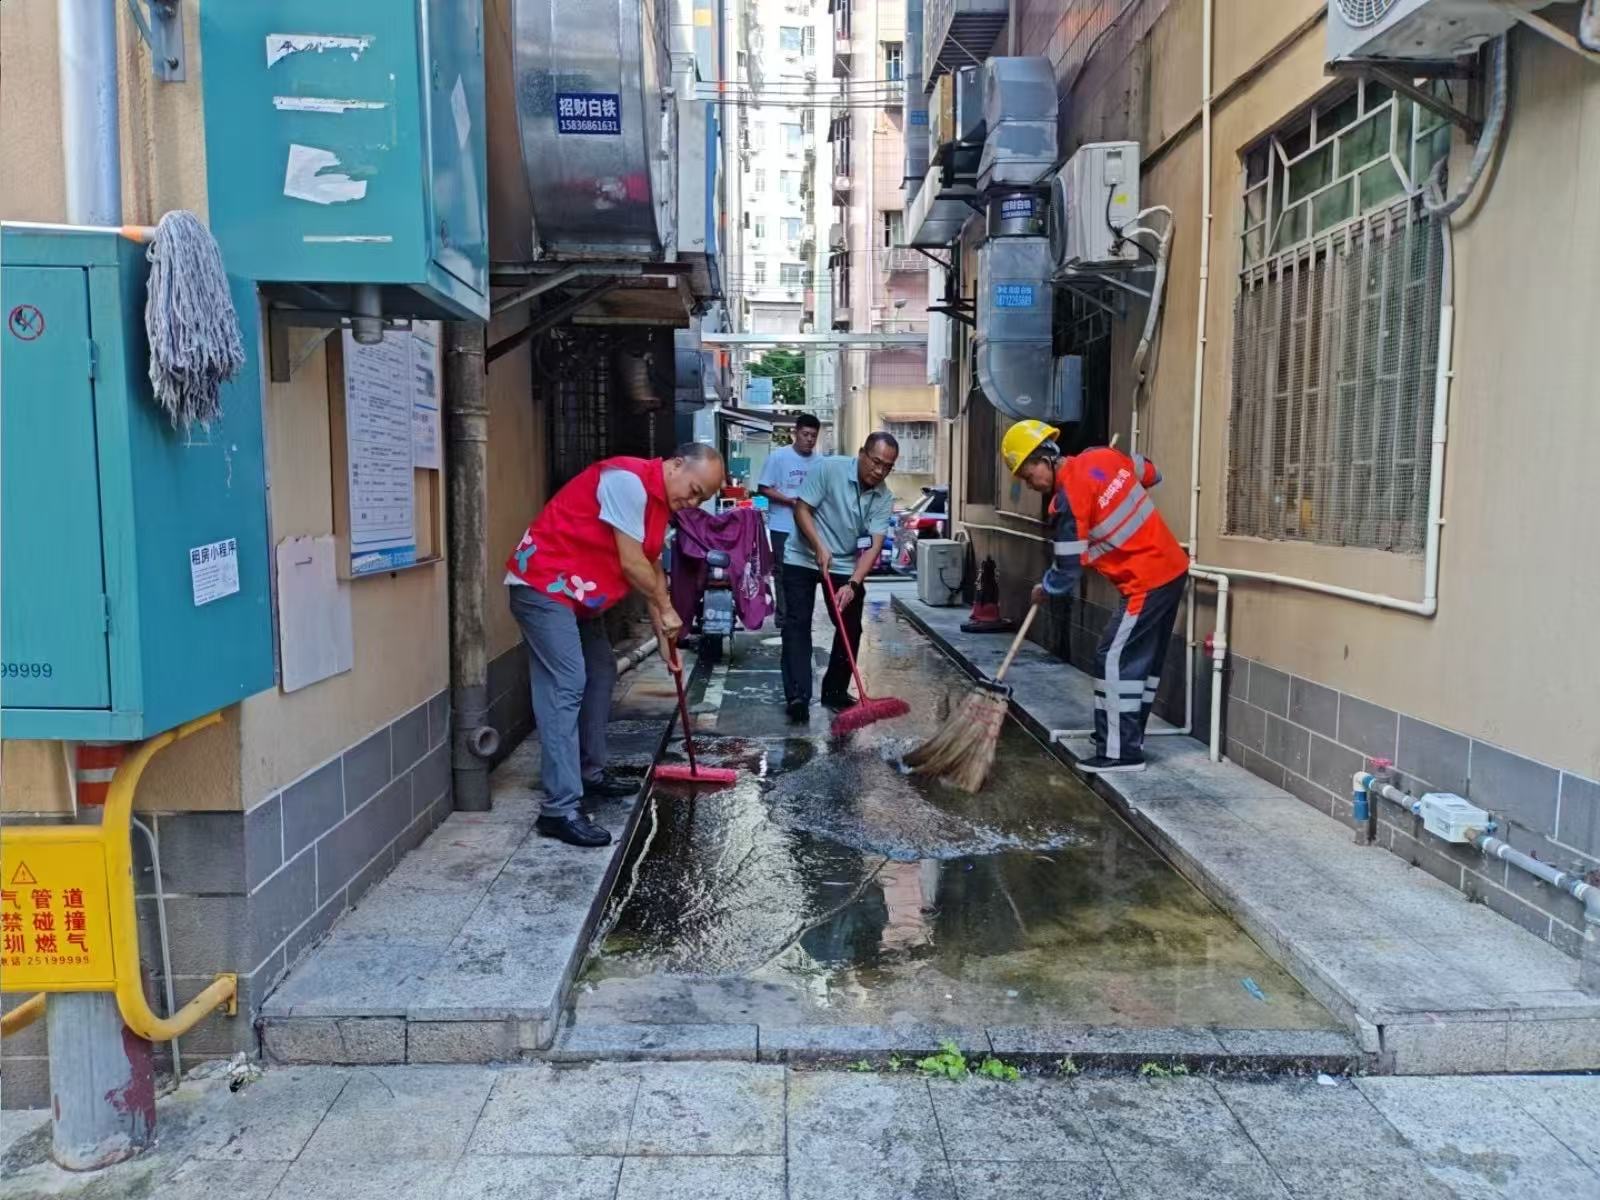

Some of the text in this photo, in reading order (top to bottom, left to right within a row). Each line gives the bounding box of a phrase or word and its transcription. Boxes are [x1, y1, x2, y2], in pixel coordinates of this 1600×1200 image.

[559, 98, 617, 117] 招财白铁
[191, 540, 236, 565] 租房小程序
[1, 888, 85, 909] 气管道
[1, 911, 87, 931] 禁碰撞
[3, 932, 89, 953] 圳燃气
